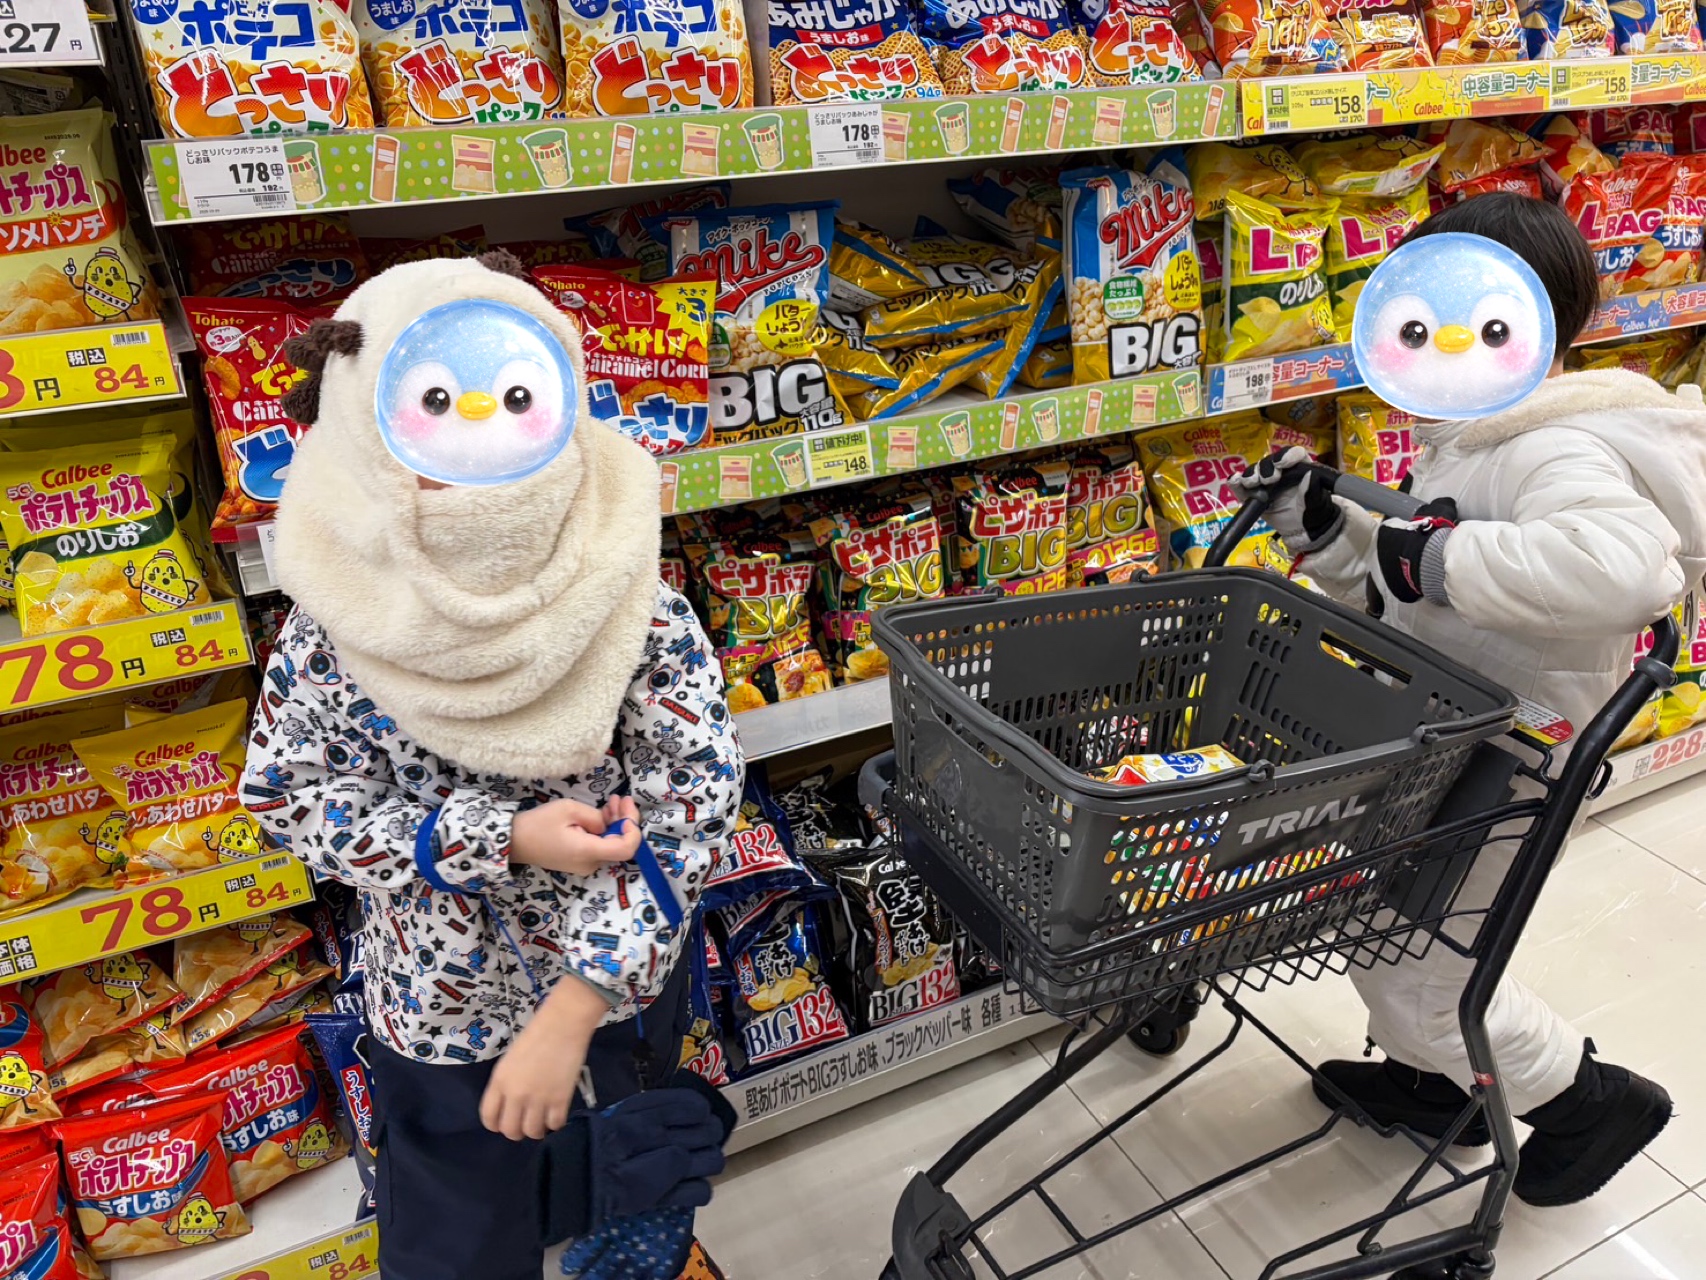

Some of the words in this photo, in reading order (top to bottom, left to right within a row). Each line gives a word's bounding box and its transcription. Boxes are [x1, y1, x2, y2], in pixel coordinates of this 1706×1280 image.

[396, 40, 562, 124] どっさり
[590, 36, 741, 117] どっさり
[781, 44, 919, 101] どっさり
[1604, 76, 1627, 95] 158
[162, 50, 350, 137] どっさり
[1333, 95, 1361, 115] 158
[1414, 102, 1443, 116] Calbee
[842, 123, 870, 142] 178
[229, 162, 270, 184] 178
[1604, 209, 1662, 239] BAG
[191, 312, 244, 326] Tohato
[66, 348, 107, 367] 税込
[1110, 313, 1199, 379] BIG
[33, 377, 62, 402] 円
[94, 363, 150, 394] 84
[155, 376, 166, 386] 円
[709, 362, 827, 429] BIG
[801, 409, 844, 432] 110g
[1183, 428, 1221, 443] Calbee
[41, 463, 113, 489] Calbee
[844, 455, 867, 473] 148
[1067, 466, 1144, 505] ザポテト
[1184, 483, 1240, 516] BA
[20, 474, 153, 534] ポテトチップス
[974, 491, 1066, 537] ピザポテ
[56, 523, 140, 557] のりしお
[834, 520, 937, 579] ピザポテ
[986, 526, 1066, 578] BIG
[706, 557, 812, 597] ピザポテ
[865, 550, 942, 602] BIG
[142, 584, 183, 606] POTATO
[150, 628, 187, 647] 税込
[175, 639, 224, 667] 84
[228, 648, 239, 657] 円
[0, 635, 114, 705] 78
[121, 657, 146, 679] 円
[135, 741, 196, 768] Calbee
[1650, 730, 1704, 772] 228
[127, 751, 229, 804] ポテトチップス
[1237, 795, 1368, 845] TRIAL
[225, 873, 256, 893] 税込
[80, 886, 192, 952] 78
[199, 903, 220, 922] 円
[246, 882, 290, 909] 84
[872, 980, 920, 1021] BIG
[981, 993, 1002, 1029] 各種
[746, 1009, 800, 1058] BIG
[769, 1038, 791, 1052] SIZE
[49, 1077, 68, 1090] 5g
[103, 1128, 170, 1153] Calbee
[309, 1249, 338, 1270] 税込
